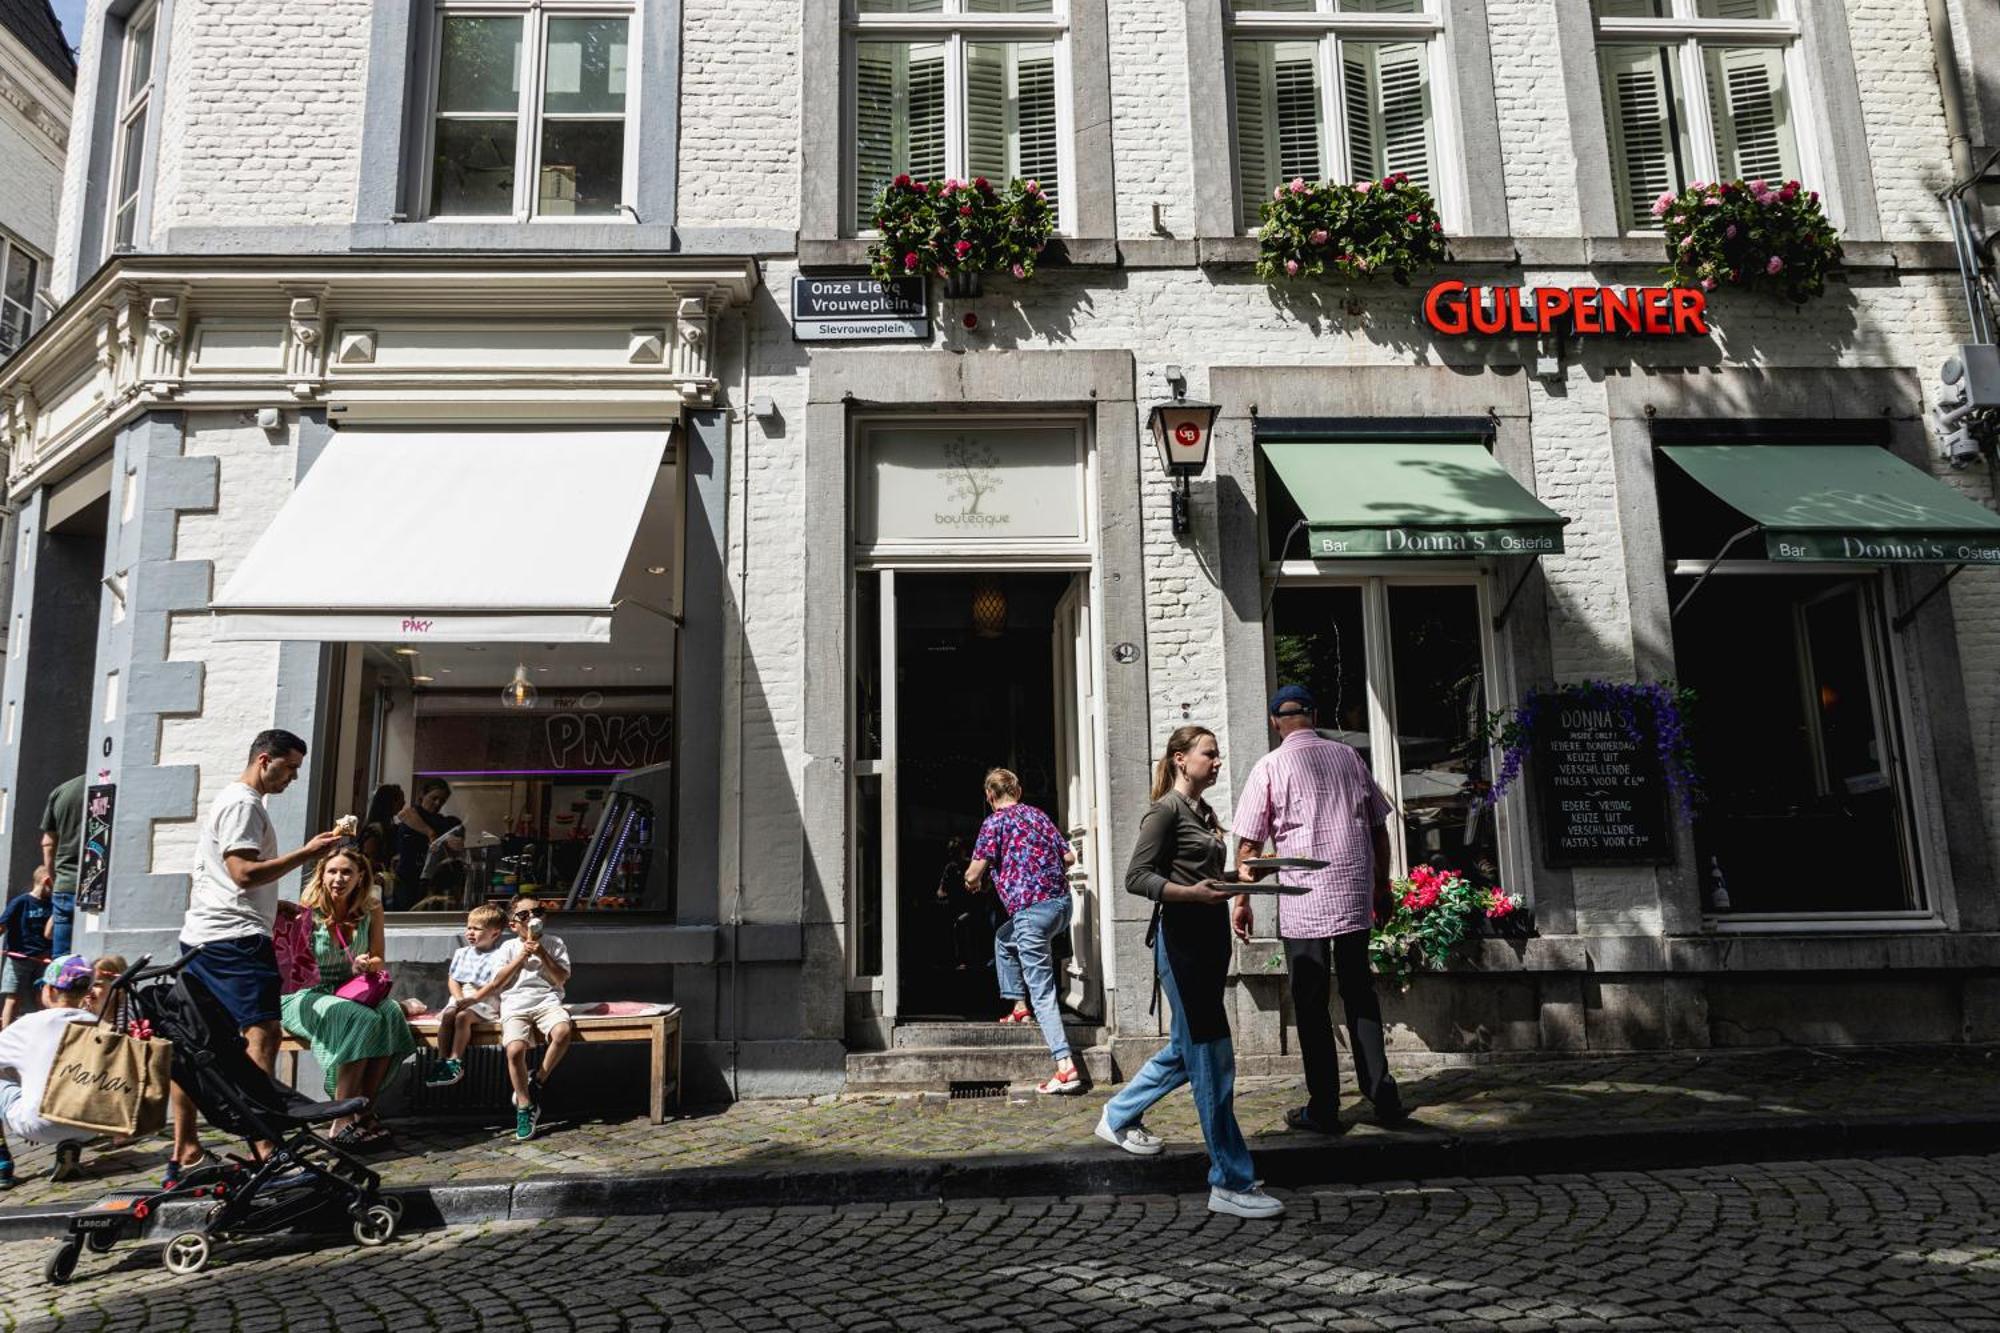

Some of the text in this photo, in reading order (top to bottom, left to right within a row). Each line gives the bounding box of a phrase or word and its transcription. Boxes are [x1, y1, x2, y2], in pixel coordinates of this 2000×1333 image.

[811, 281, 901, 295] Onze Lieve
[811, 297, 909, 312] Vrouweplein
[1424, 280, 1708, 335] GULPENER
[819, 323, 905, 334] Slevrouweplein
[1322, 539, 1349, 552] Bar
[1500, 536, 1553, 549] Osteria
[1779, 536, 2000, 560] Bar Donna's Osteri
[1566, 752, 1619, 762] KEUZE UIT
[1592, 776, 1617, 786] VOOR
[1561, 800, 1591, 812] IEDERE
[1571, 812, 1622, 823] KEUZE UIT
[1603, 836, 1626, 848] VOOR
